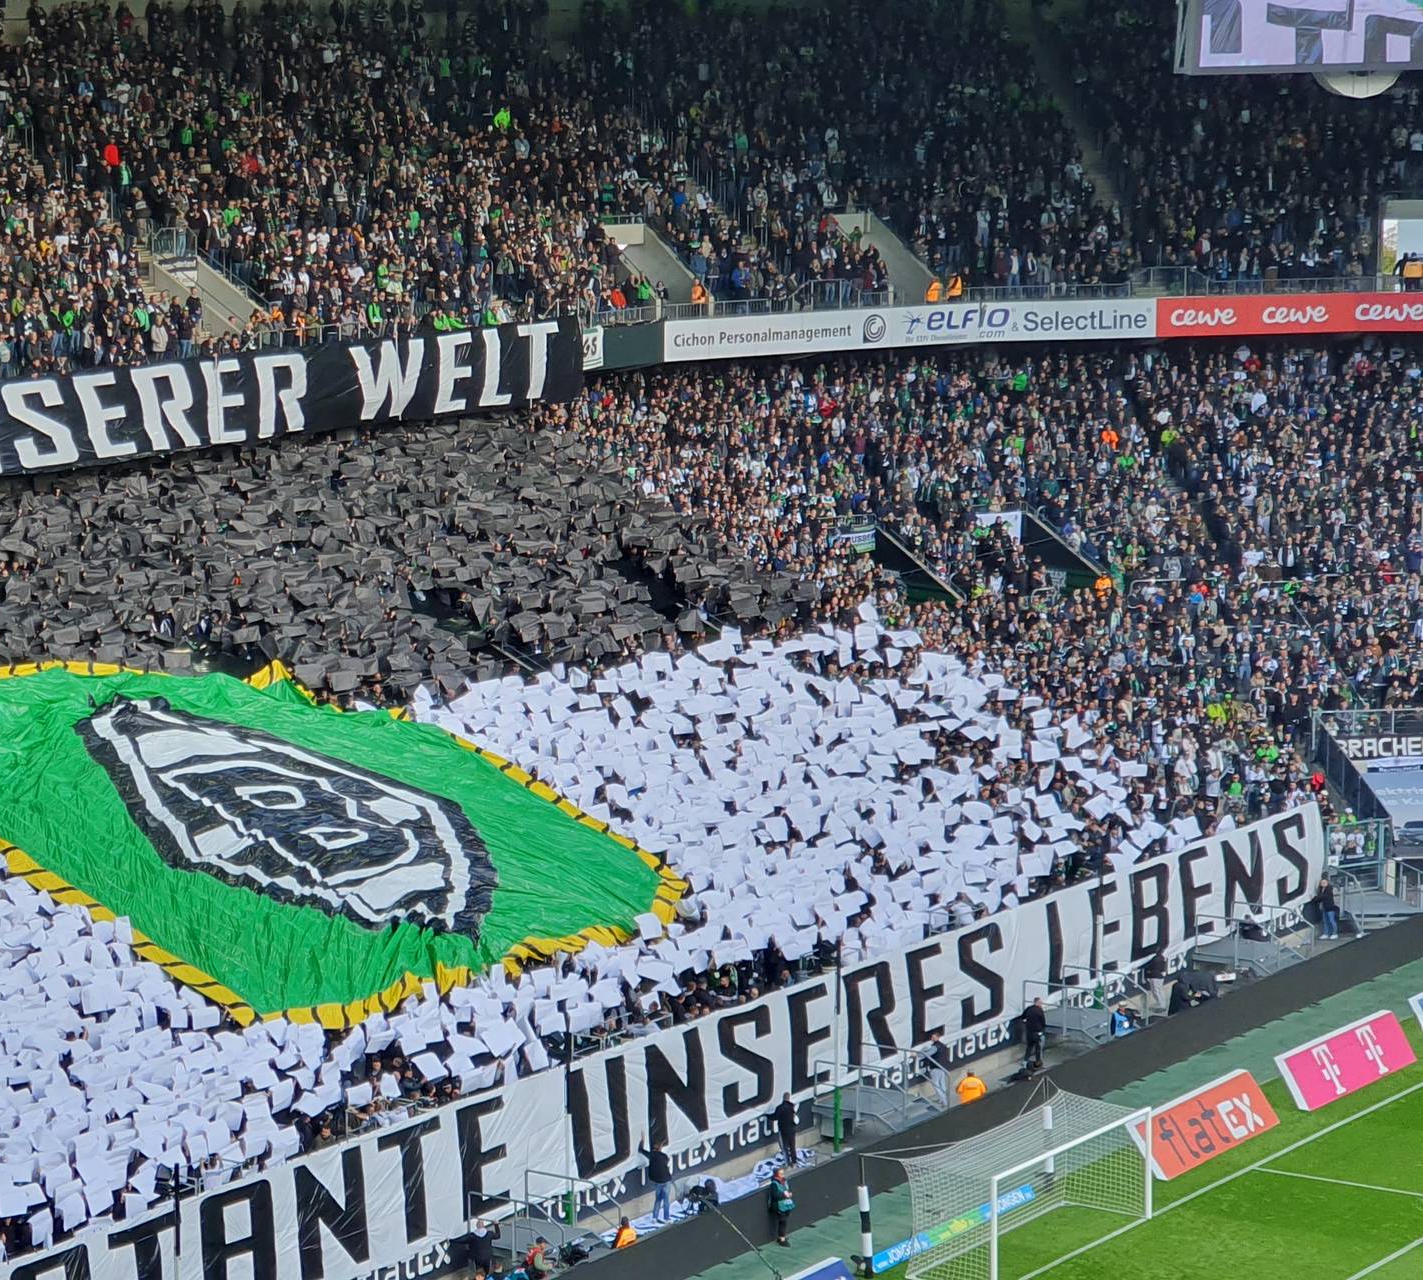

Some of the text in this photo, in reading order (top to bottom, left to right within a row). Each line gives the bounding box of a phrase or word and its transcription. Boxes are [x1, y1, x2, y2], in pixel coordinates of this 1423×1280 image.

[674, 323, 852, 347] Cichon Personalmanagement
[1023, 308, 1147, 332] SelectLine
[1170, 306, 1237, 326] cewe
[1262, 304, 1329, 324] cewe
[352, 321, 559, 421] WELT
[565, 921, 1004, 1180] UNSERES
[1045, 813, 1309, 995] LEBENS
[1158, 1093, 1264, 1166] flatEX
